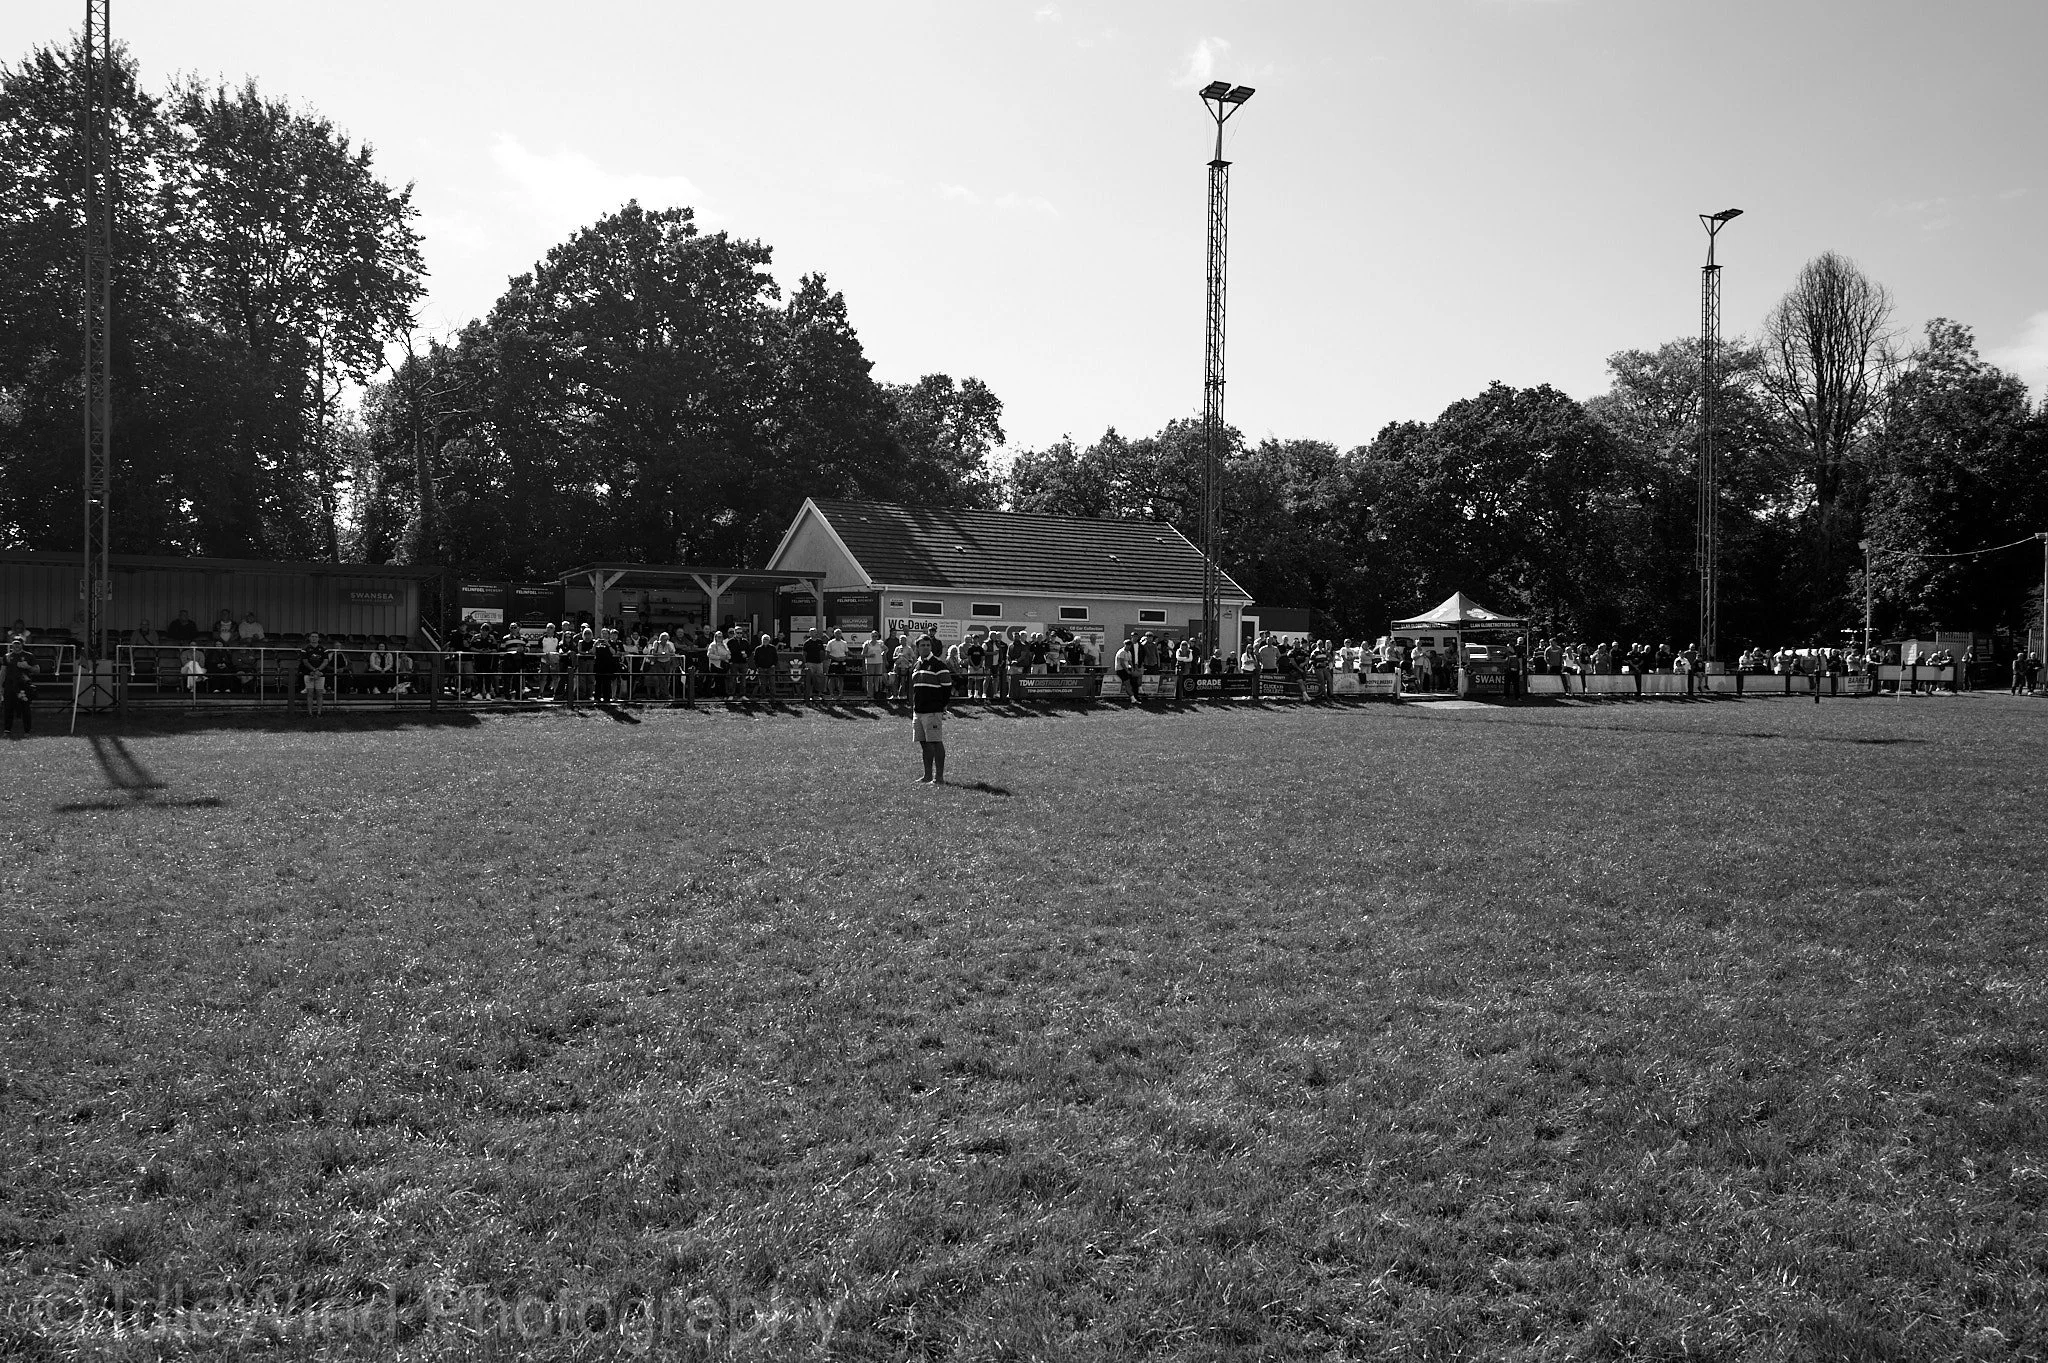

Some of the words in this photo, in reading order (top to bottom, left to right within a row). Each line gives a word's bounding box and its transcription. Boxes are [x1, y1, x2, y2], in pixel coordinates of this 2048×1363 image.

[350, 592, 394, 600] SWANSEA
[1019, 679, 1035, 687] TDW
[1035, 679, 1078, 687] DISTRIBUTION
